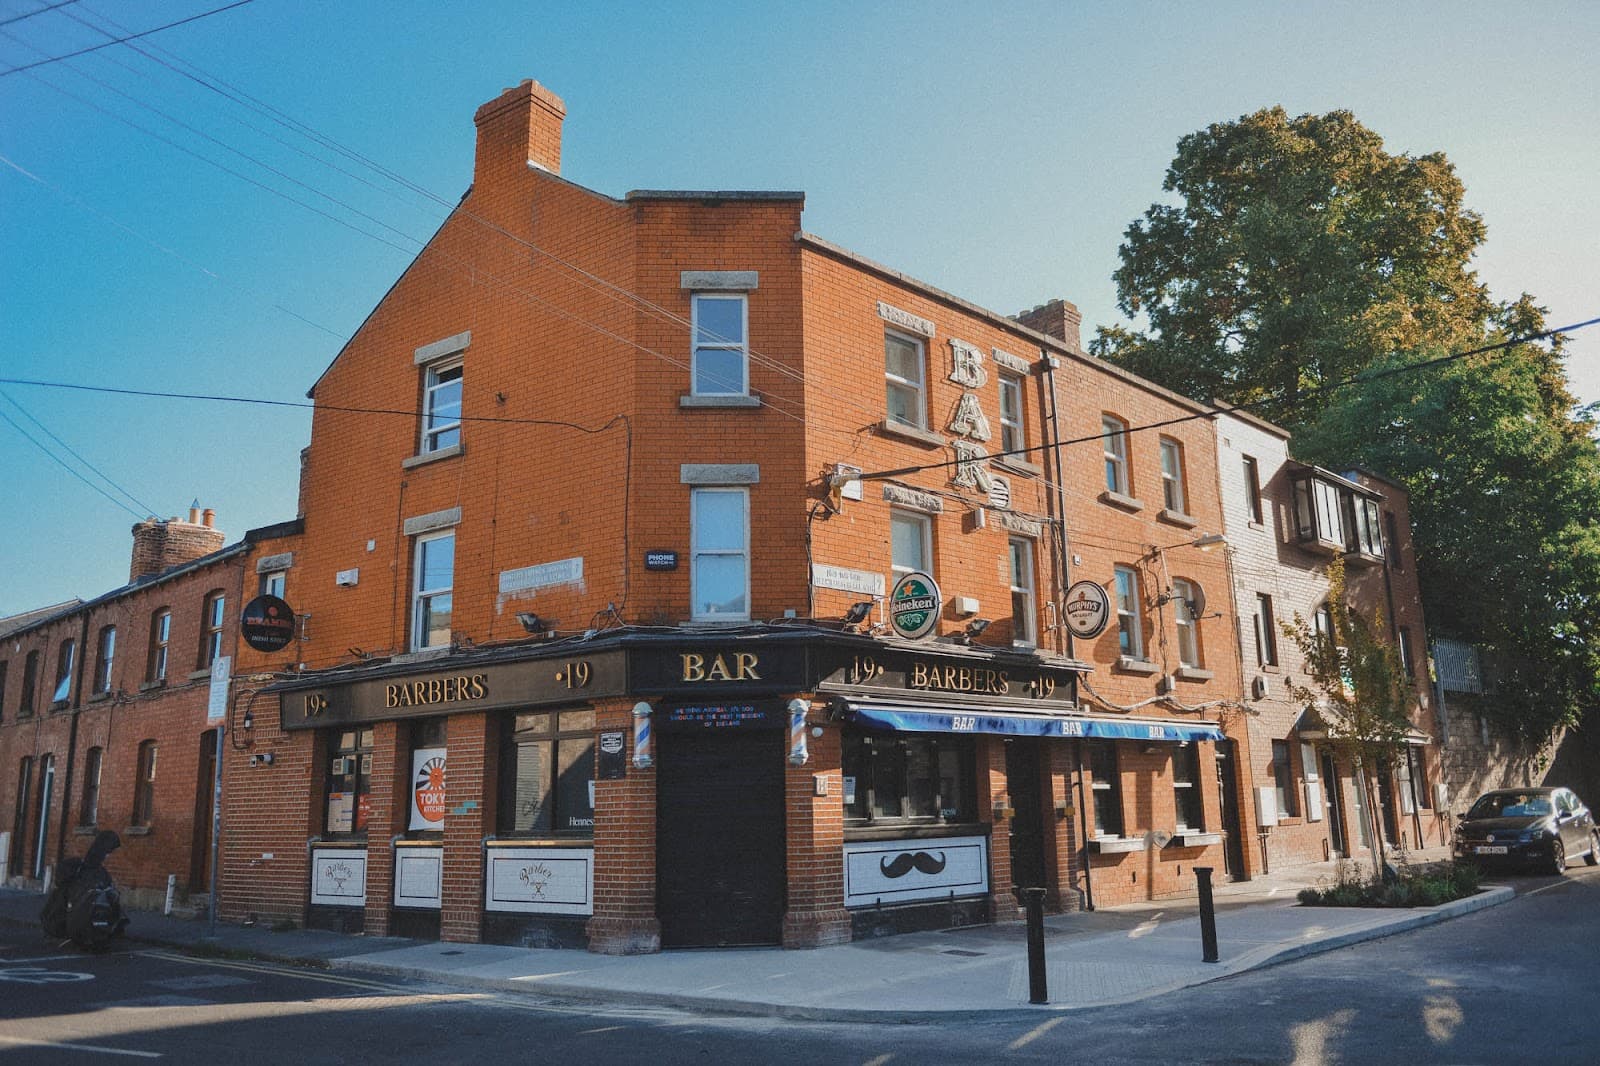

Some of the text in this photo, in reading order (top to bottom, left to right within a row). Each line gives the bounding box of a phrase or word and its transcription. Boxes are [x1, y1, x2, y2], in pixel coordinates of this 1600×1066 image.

[949, 338, 993, 493] BAR
[679, 652, 763, 681] BAR
[852, 656, 1055, 698] 19 BARBERS 19
[303, 661, 591, 717] 19 BARBERS 19
[952, 716, 976, 731] BAR
[1062, 721, 1082, 735] BAR
[1149, 726, 1164, 738] BAR
